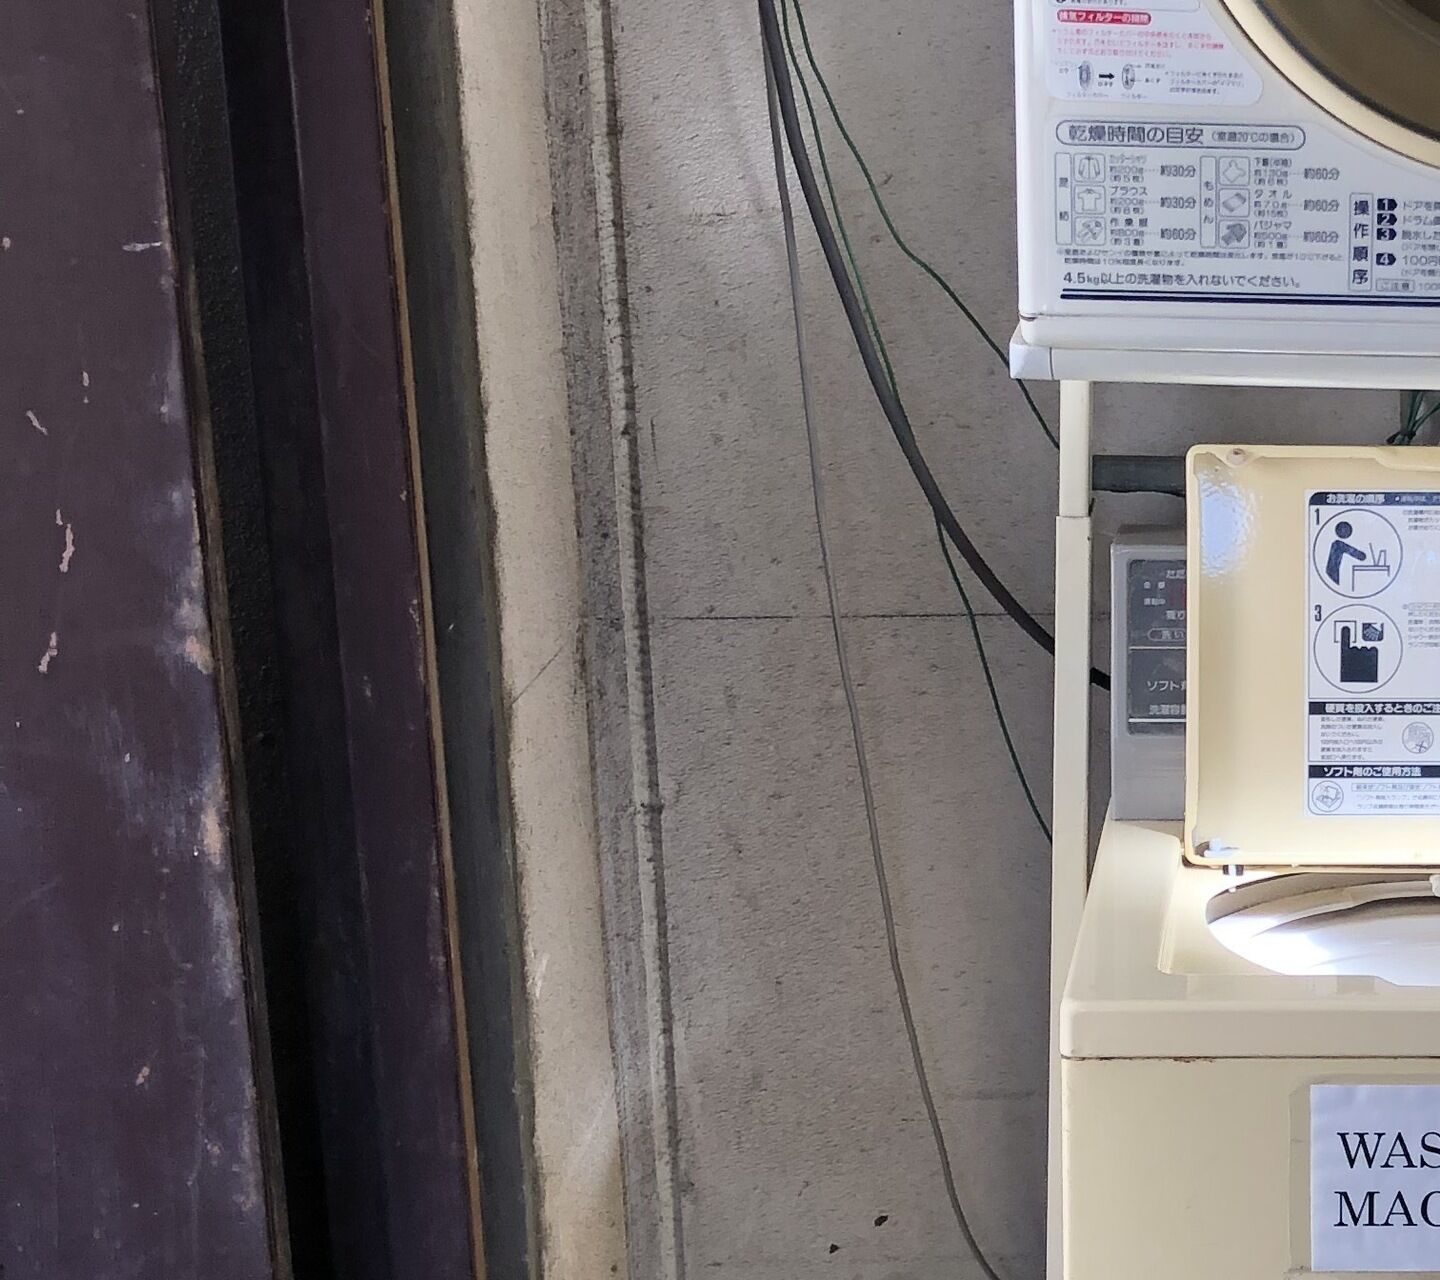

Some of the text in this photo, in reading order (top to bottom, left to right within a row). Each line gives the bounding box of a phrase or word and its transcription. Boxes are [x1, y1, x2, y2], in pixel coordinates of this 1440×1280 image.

[1068, 125, 1204, 145] 乾燥時間の目安
[1203, 180, 1214, 224] もめん
[1352, 200, 1370, 285] 操作順序
[1314, 508, 1320, 525] 1
[1314, 604, 1322, 622] 3
